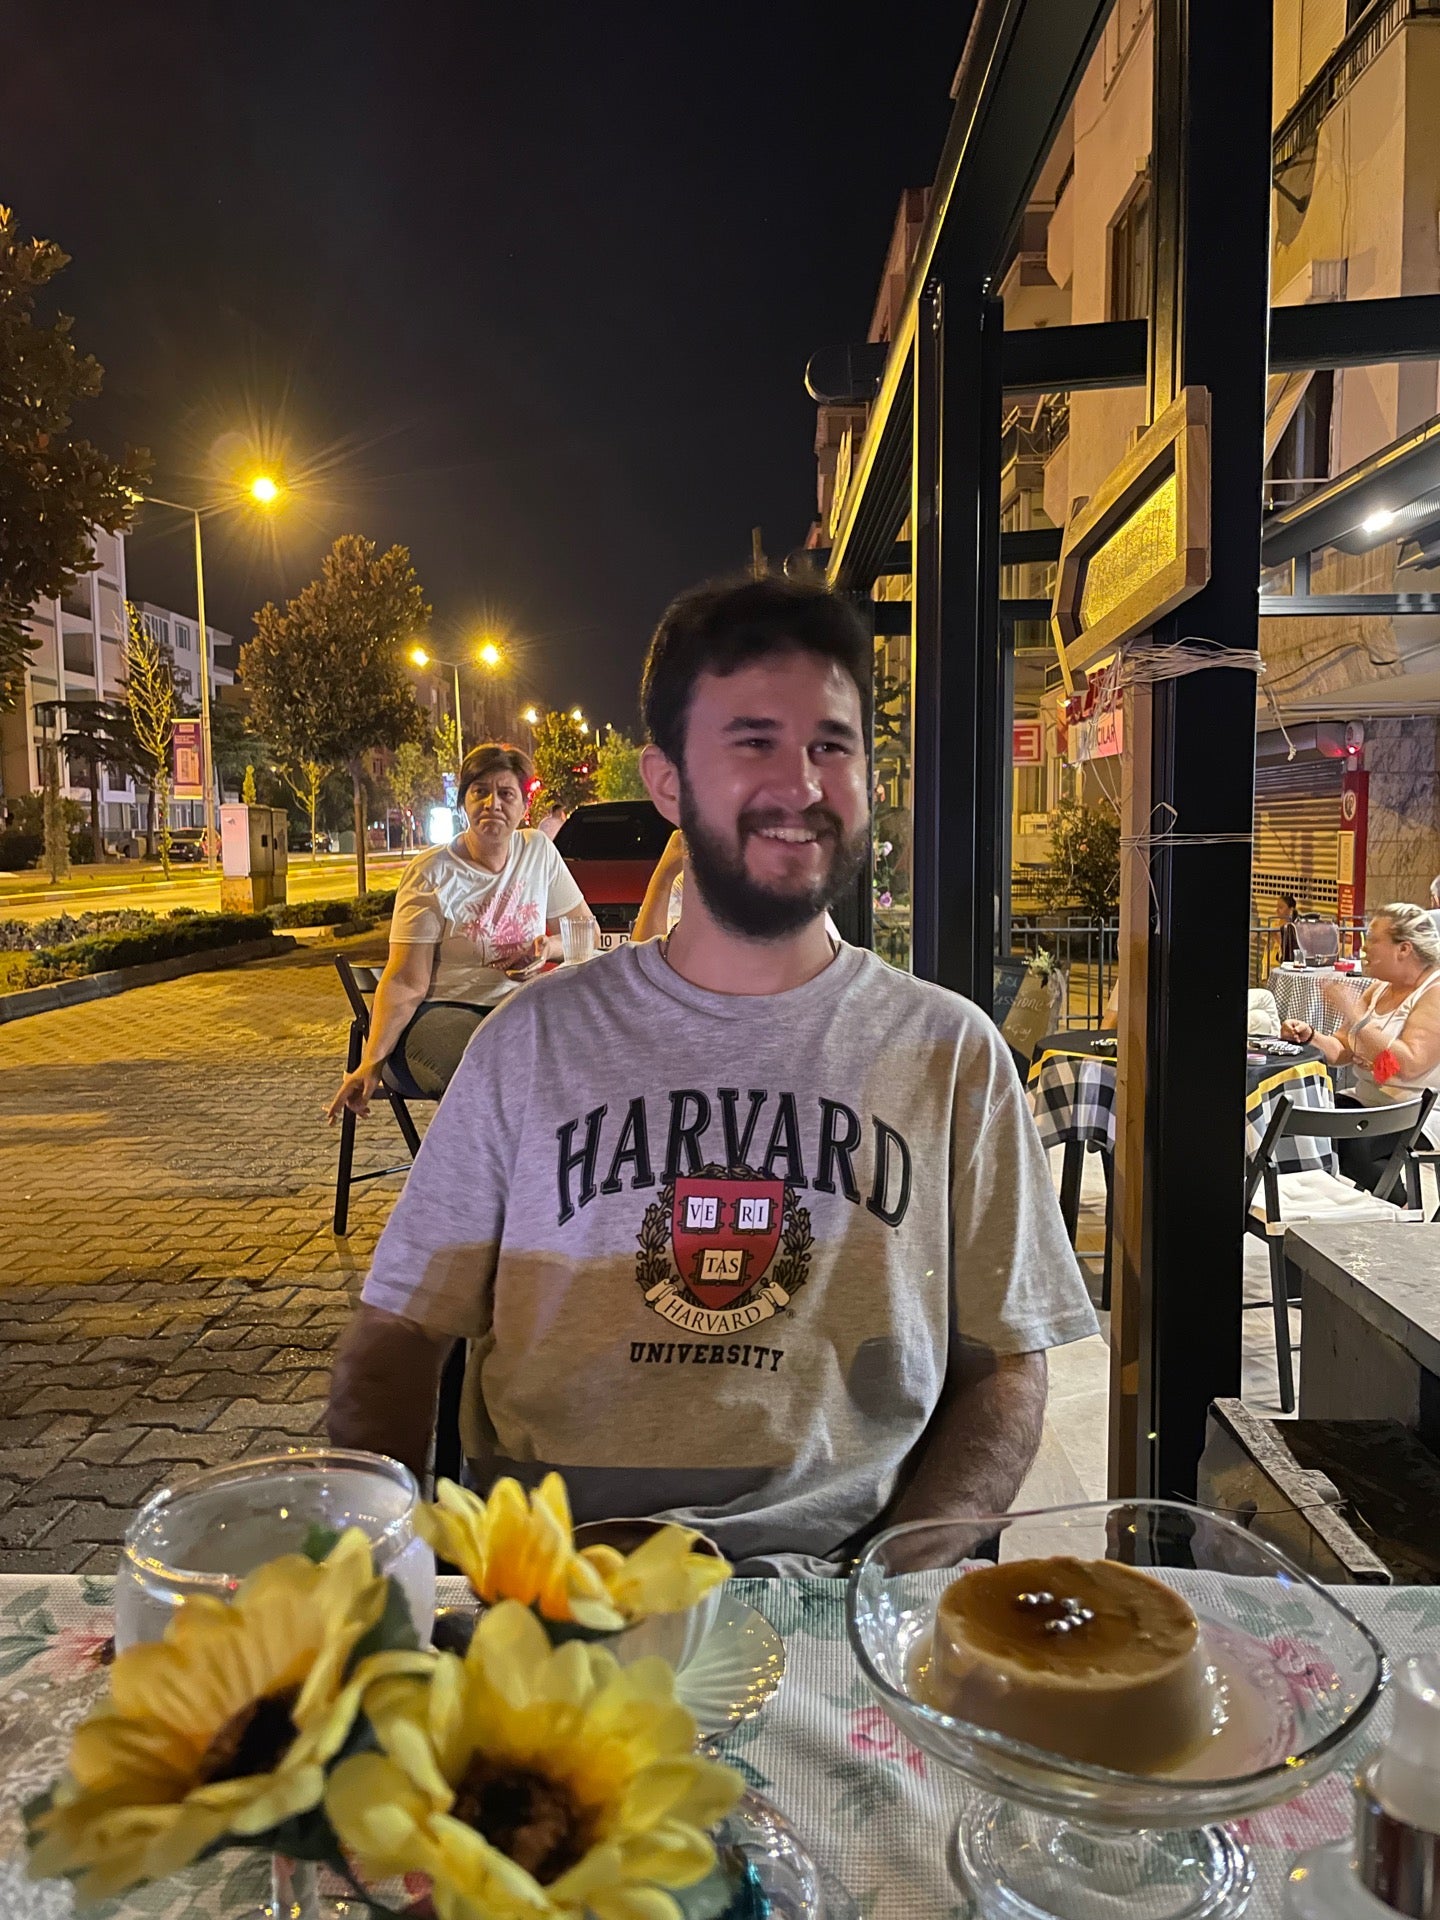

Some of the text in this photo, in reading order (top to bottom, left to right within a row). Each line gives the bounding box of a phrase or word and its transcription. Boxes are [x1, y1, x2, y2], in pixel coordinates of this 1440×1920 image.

[556, 1087, 912, 1228] HARVARD
[690, 1204, 764, 1222] VE RI
[706, 1257, 739, 1274] TAS
[663, 1299, 761, 1332] HARVARD
[630, 1341, 784, 1371] UNIVERSITY
